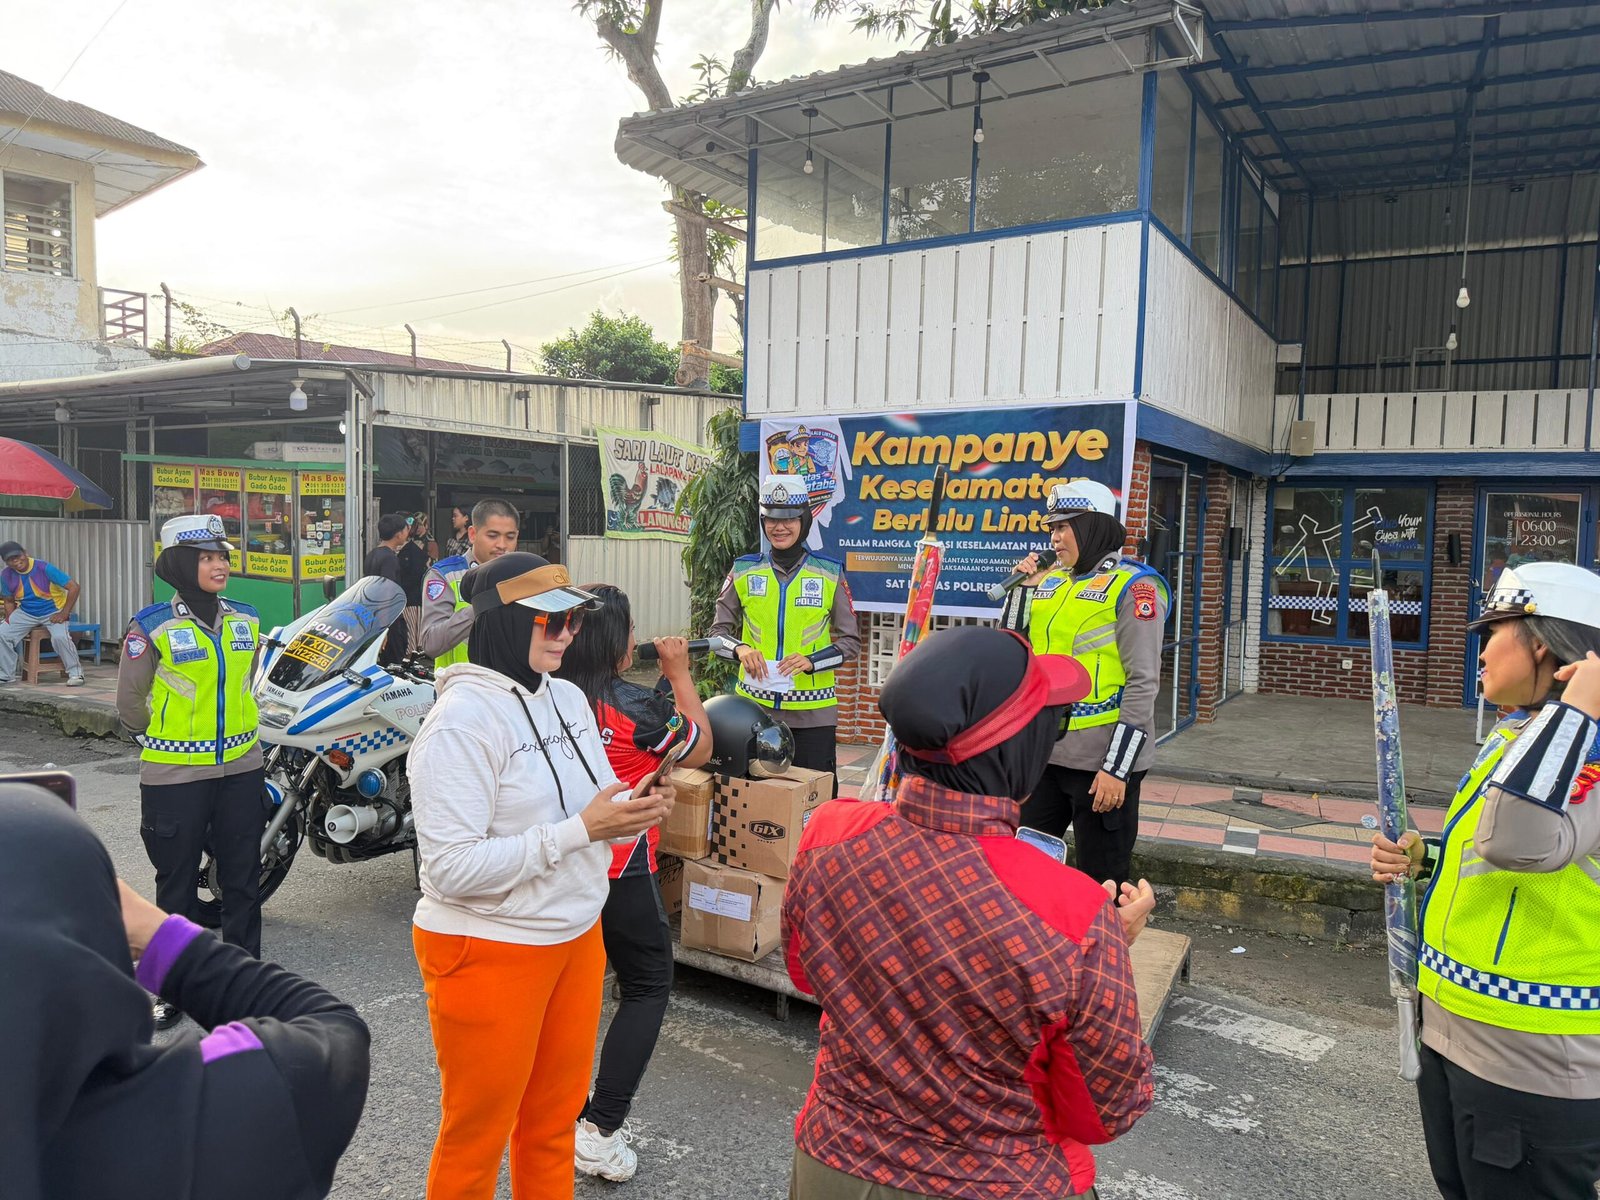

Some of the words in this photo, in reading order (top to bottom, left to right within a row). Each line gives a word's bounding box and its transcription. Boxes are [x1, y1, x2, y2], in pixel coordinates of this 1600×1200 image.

[613, 438, 646, 461] SARI
[649, 440, 684, 467] LAUT
[851, 429, 1109, 471] Kampanye
[156, 467, 173, 475] Bubur
[175, 469, 191, 477] Ayam
[199, 468, 215, 476] Mas
[217, 469, 240, 477] Bowo
[248, 473, 267, 481] Bubur
[269, 475, 288, 483] Ayam
[302, 474, 322, 482] Mas
[803, 473, 820, 482] ntas
[250, 482, 266, 490] Gado
[268, 483, 286, 491] Gado
[805, 479, 836, 492] atabe
[859, 472, 1089, 500] Keseamata
[639, 511, 690, 531] LAONGA
[981, 506, 1050, 533] Lint
[1398, 513, 1423, 527] Your
[1521, 519, 1557, 532] 06:00
[1374, 529, 1398, 543] Eyes
[1520, 534, 1556, 546] 23:00
[839, 538, 870, 548] DALAM
[872, 540, 912, 548] RANGKA
[914, 540, 954, 549] OASI
[956, 540, 1028, 551] KESELAMATAN
[249, 555, 268, 563] Bubur
[270, 557, 289, 566] Ayam
[305, 558, 327, 566] Bubur
[251, 564, 268, 572] Gado
[269, 565, 287, 573] Gado
[306, 566, 326, 574] Gado
[885, 579, 905, 589] SAT
[795, 598, 822, 606] POLISI
[1078, 591, 1107, 602] POLRI
[308, 620, 354, 645] POLISI
[231, 641, 256, 651] POLISI
[309, 639, 334, 654] XIV
[297, 647, 330, 668] 122546
[266, 685, 285, 698] YAMAHA
[379, 687, 414, 702] YAMAHA
[395, 701, 435, 720] POLIS
[753, 823, 780, 837] GIX
